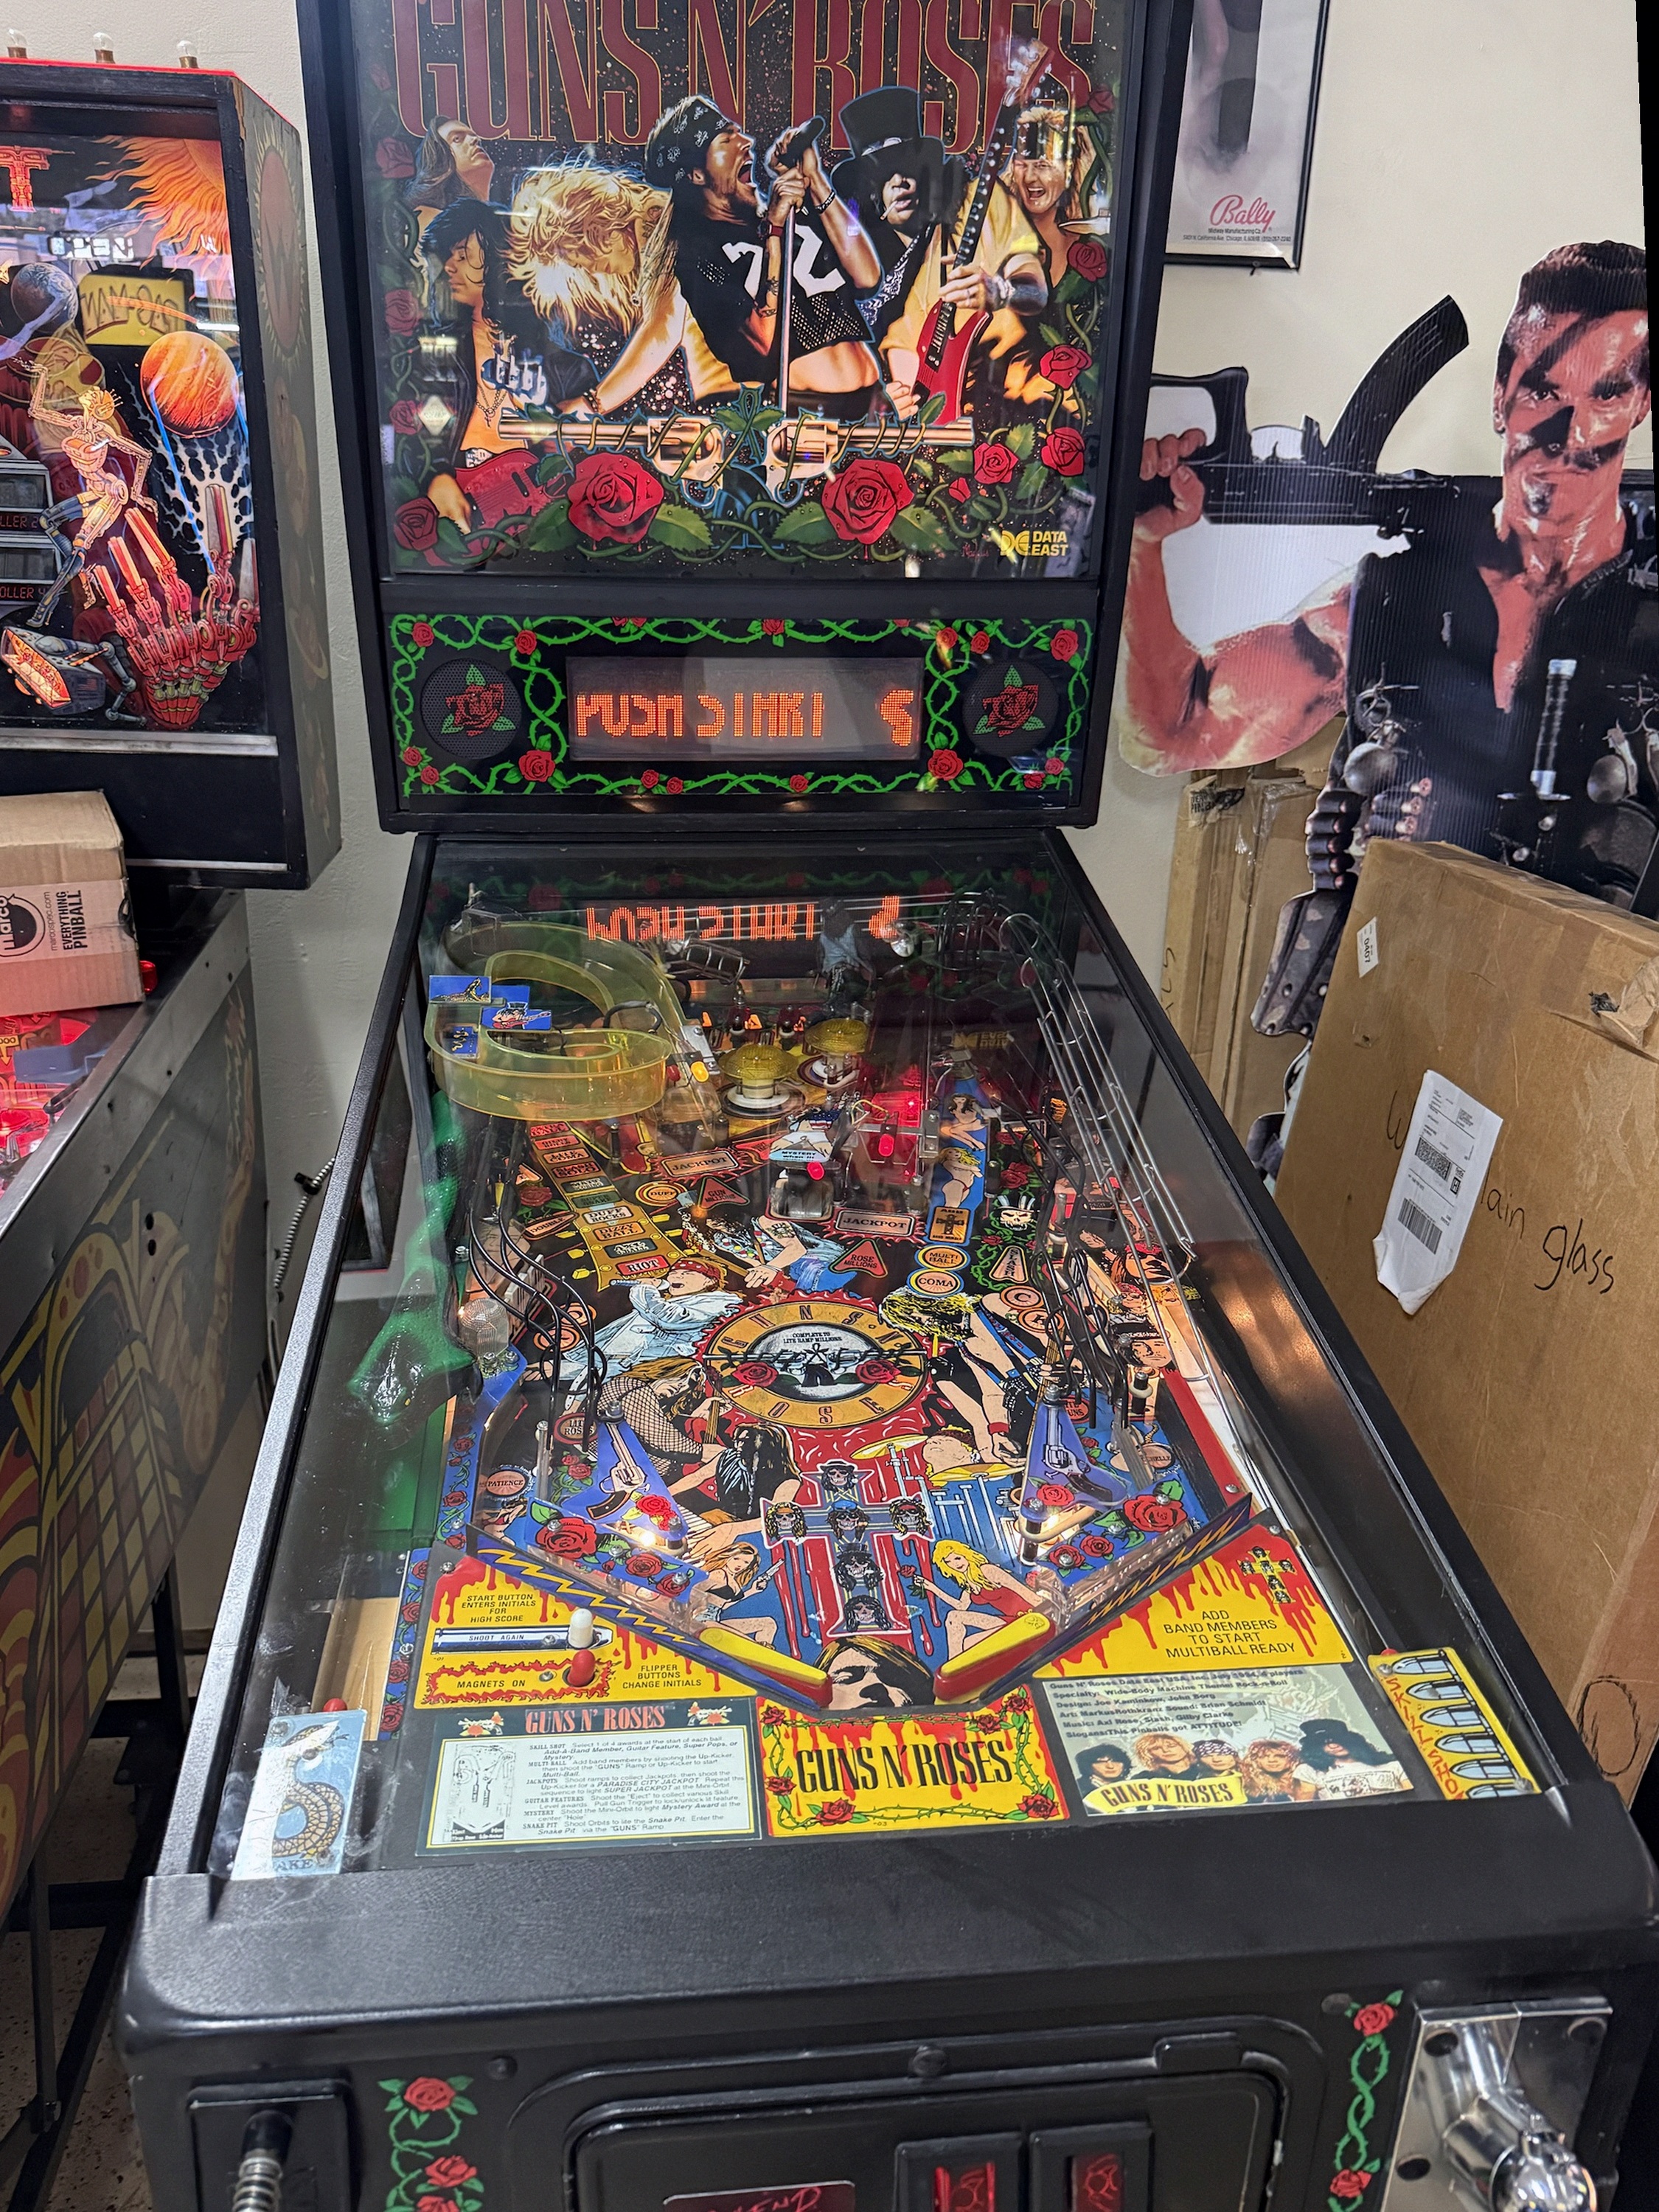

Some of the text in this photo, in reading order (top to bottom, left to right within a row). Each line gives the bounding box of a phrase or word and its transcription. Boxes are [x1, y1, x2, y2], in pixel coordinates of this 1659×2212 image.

[1209, 195, 1276, 233] Bally
[1032, 531, 1068, 543] DATA
[1032, 544, 1069, 557] EAST
[44, 891, 58, 951] marcospec.com
[56, 891, 73, 950] EVERYTHING
[67, 890, 88, 949] PINBALL
[672, 1157, 728, 1171] JACKPOT
[705, 1193, 737, 1203] MILLIONS
[589, 1208, 623, 1218] DUFF
[591, 1213, 627, 1222] ROCKS
[530, 1217, 566, 1233] DOUBLE
[599, 1224, 633, 1234] DIZZY
[843, 1218, 908, 1229] JACKPOT
[603, 1228, 639, 1239] BALL
[852, 1254, 875, 1262] ROSE
[929, 1252, 959, 1260] MULTI
[1534, 1218, 1615, 1294] glass
[627, 1259, 659, 1273] RIOT
[844, 1260, 877, 1269] MILLIONS
[1004, 1248, 1018, 1277] SLASH
[919, 1277, 953, 1288] COMA
[565, 1425, 594, 1436] ROSS
[487, 1479, 524, 1487] PATIENCE
[1202, 1610, 1230, 1621] ADD
[1164, 1619, 1278, 1635] BAND MEMBERS
[1188, 1632, 1262, 1645] TO START
[1165, 1642, 1295, 1659] MULTIBALL READY
[637, 1672, 681, 1680] BUTTONS
[1270, 1668, 1304, 1678] players
[456, 1680, 505, 1688] MAGNETS
[622, 1679, 702, 1689] CHANGE INITIALS
[1104, 1686, 1155, 1695] Wide-Body
[1157, 1684, 1196, 1692] Machine
[1227, 1699, 1267, 1708] Schmidt
[525, 1709, 576, 1734] GUNS
[604, 1705, 667, 1731] ROSES
[1175, 1713, 1201, 1721] Gilby
[1202, 1711, 1234, 1719] Clarke
[796, 1739, 1014, 1793] GUNS N' ROSES
[1100, 1782, 1153, 1806] GUNS
[1175, 1782, 1234, 1804] ROSES
